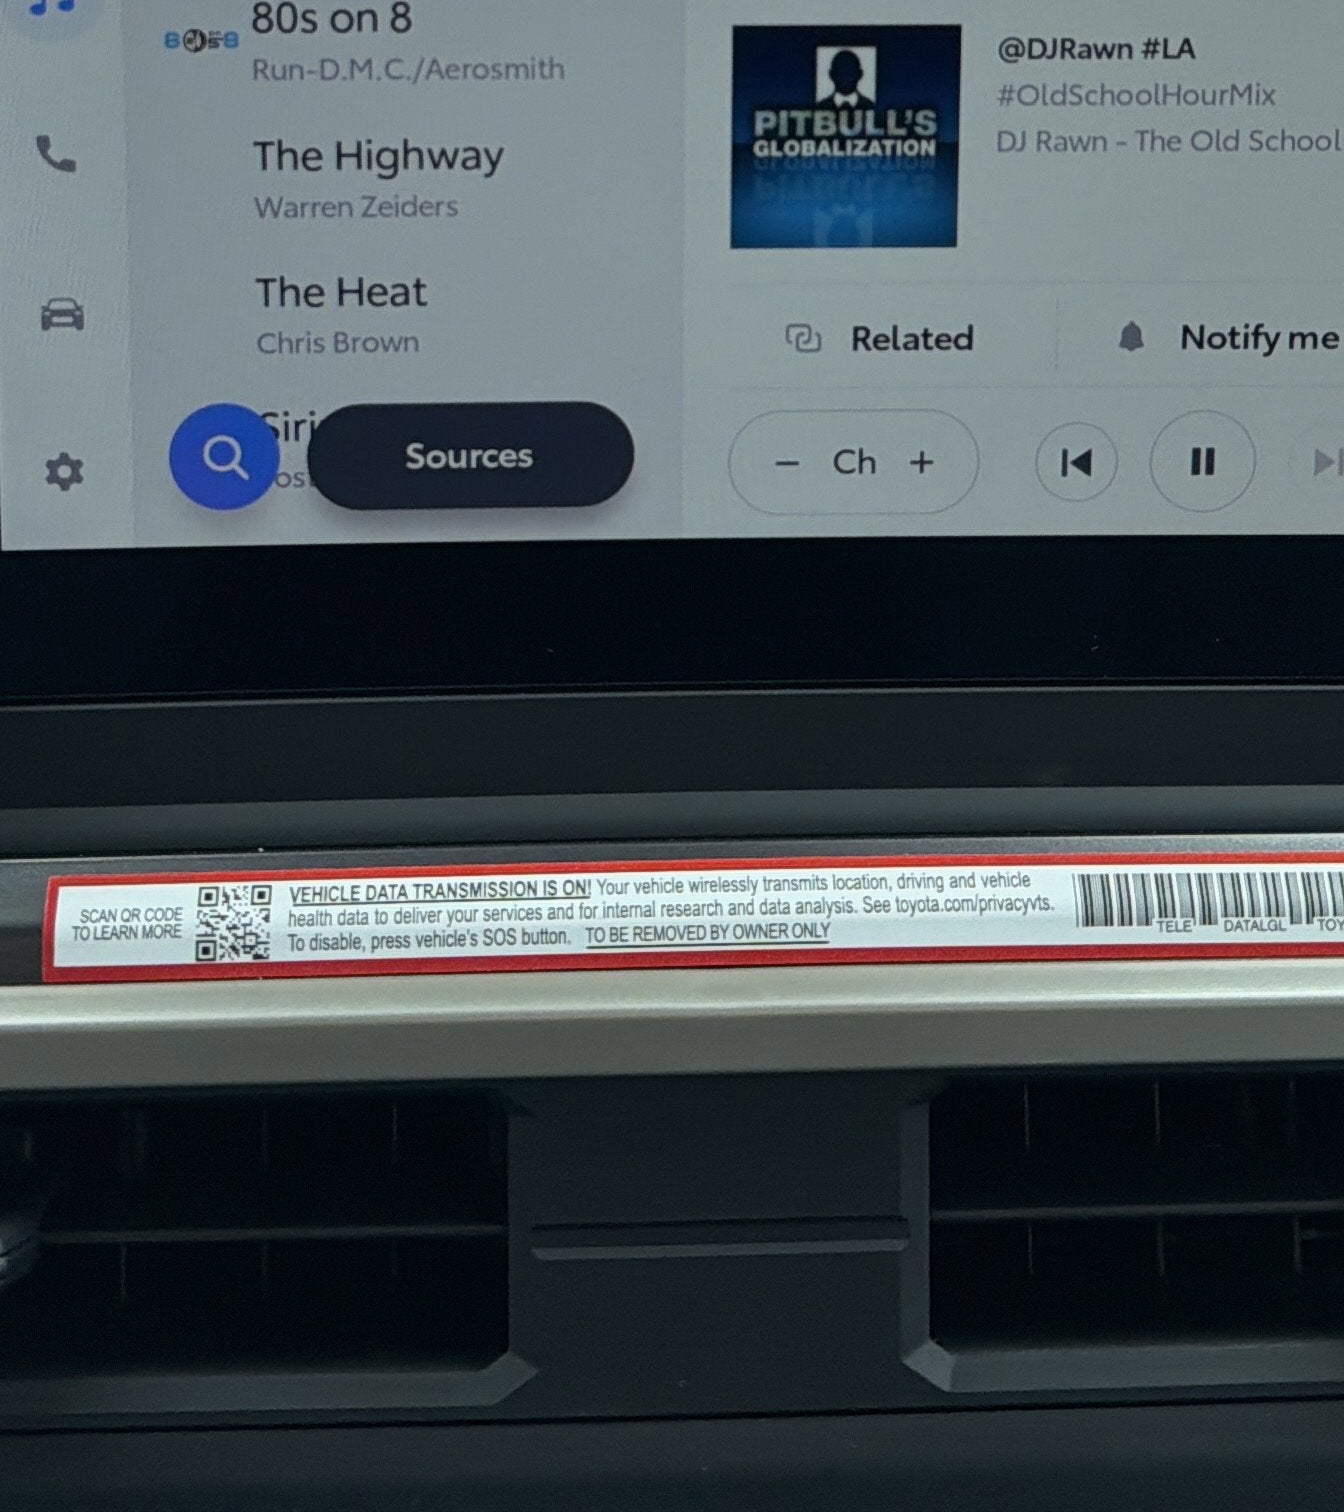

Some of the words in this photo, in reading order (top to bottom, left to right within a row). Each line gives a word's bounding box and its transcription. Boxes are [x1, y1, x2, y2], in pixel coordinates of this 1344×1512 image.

[251, 0, 318, 34] 80s
[329, 8, 379, 34] on
[389, 0, 413, 34] 8
[998, 36, 1134, 64] @DJRawn
[1141, 37, 1196, 60] #LA
[252, 56, 565, 85] Run-D.M.C./Aerosmith
[997, 82, 1276, 107] #OldSchoolHourMix
[755, 109, 938, 137] PITBULL'S
[753, 138, 936, 157] GLOBALIZATION
[996, 129, 1027, 153] DJ
[1036, 129, 1108, 153] Rawn
[1134, 128, 1183, 153] The
[1190, 128, 1240, 152] Old
[1248, 128, 1342, 152] School
[252, 138, 324, 172] The
[335, 138, 504, 181] Highway
[253, 196, 354, 219] Warren
[360, 194, 459, 219] Zeiders
[255, 275, 326, 308] The
[337, 276, 428, 308] Heat
[256, 330, 326, 355] Chris
[333, 330, 420, 354] Brown
[852, 324, 974, 352] Related
[1181, 322, 1281, 358] Notify
[1288, 331, 1340, 350] me
[406, 442, 534, 470] Sources
[833, 447, 876, 475] Ch
[290, 885, 360, 902] VEHICLE
[366, 884, 407, 900] DATA
[413, 880, 537, 899] TRANSMISSION
[544, 880, 557, 896] IS
[563, 879, 591, 896] ON!
[597, 879, 629, 895] Your
[634, 877, 684, 894] vehicle
[689, 876, 758, 896] wirelessly
[763, 874, 828, 892] transmits
[833, 874, 892, 891] location,
[897, 872, 944, 893] driving
[949, 872, 976, 888] and
[981, 871, 1031, 887] vehicle
[80, 908, 117, 923] SCAN
[121, 908, 141, 923] QR
[145, 907, 183, 922] CODE
[288, 909, 332, 927] health
[337, 908, 369, 925] data
[374, 908, 388, 925] to
[394, 907, 442, 924] deliver
[446, 908, 478, 927] your
[482, 905, 543, 921] services
[547, 903, 574, 920] and
[578, 901, 597, 919] for
[602, 900, 656, 918] internal
[660, 899, 723, 917] research
[728, 898, 755, 916] and
[759, 898, 791, 915] data
[795, 896, 859, 919] analysis.
[862, 896, 891, 913] See
[895, 894, 1056, 917] toyota.com/privacyvts.
[72, 926, 90, 941] TO
[94, 925, 137, 940] LEARN
[142, 924, 182, 938] MORE
[287, 934, 305, 951] To
[309, 932, 366, 953] disable,
[370, 934, 411, 954] press
[415, 930, 478, 948] vehicle's
[482, 929, 517, 946] SOS
[521, 926, 571, 945] button.
[586, 926, 605, 943] TO
[609, 926, 629, 942] BE
[633, 924, 707, 941] REMOVED
[710, 924, 730, 940] BY
[733, 922, 788, 939] OWNER
[792, 921, 831, 939] ONLY
[1156, 920, 1193, 933] TELE
